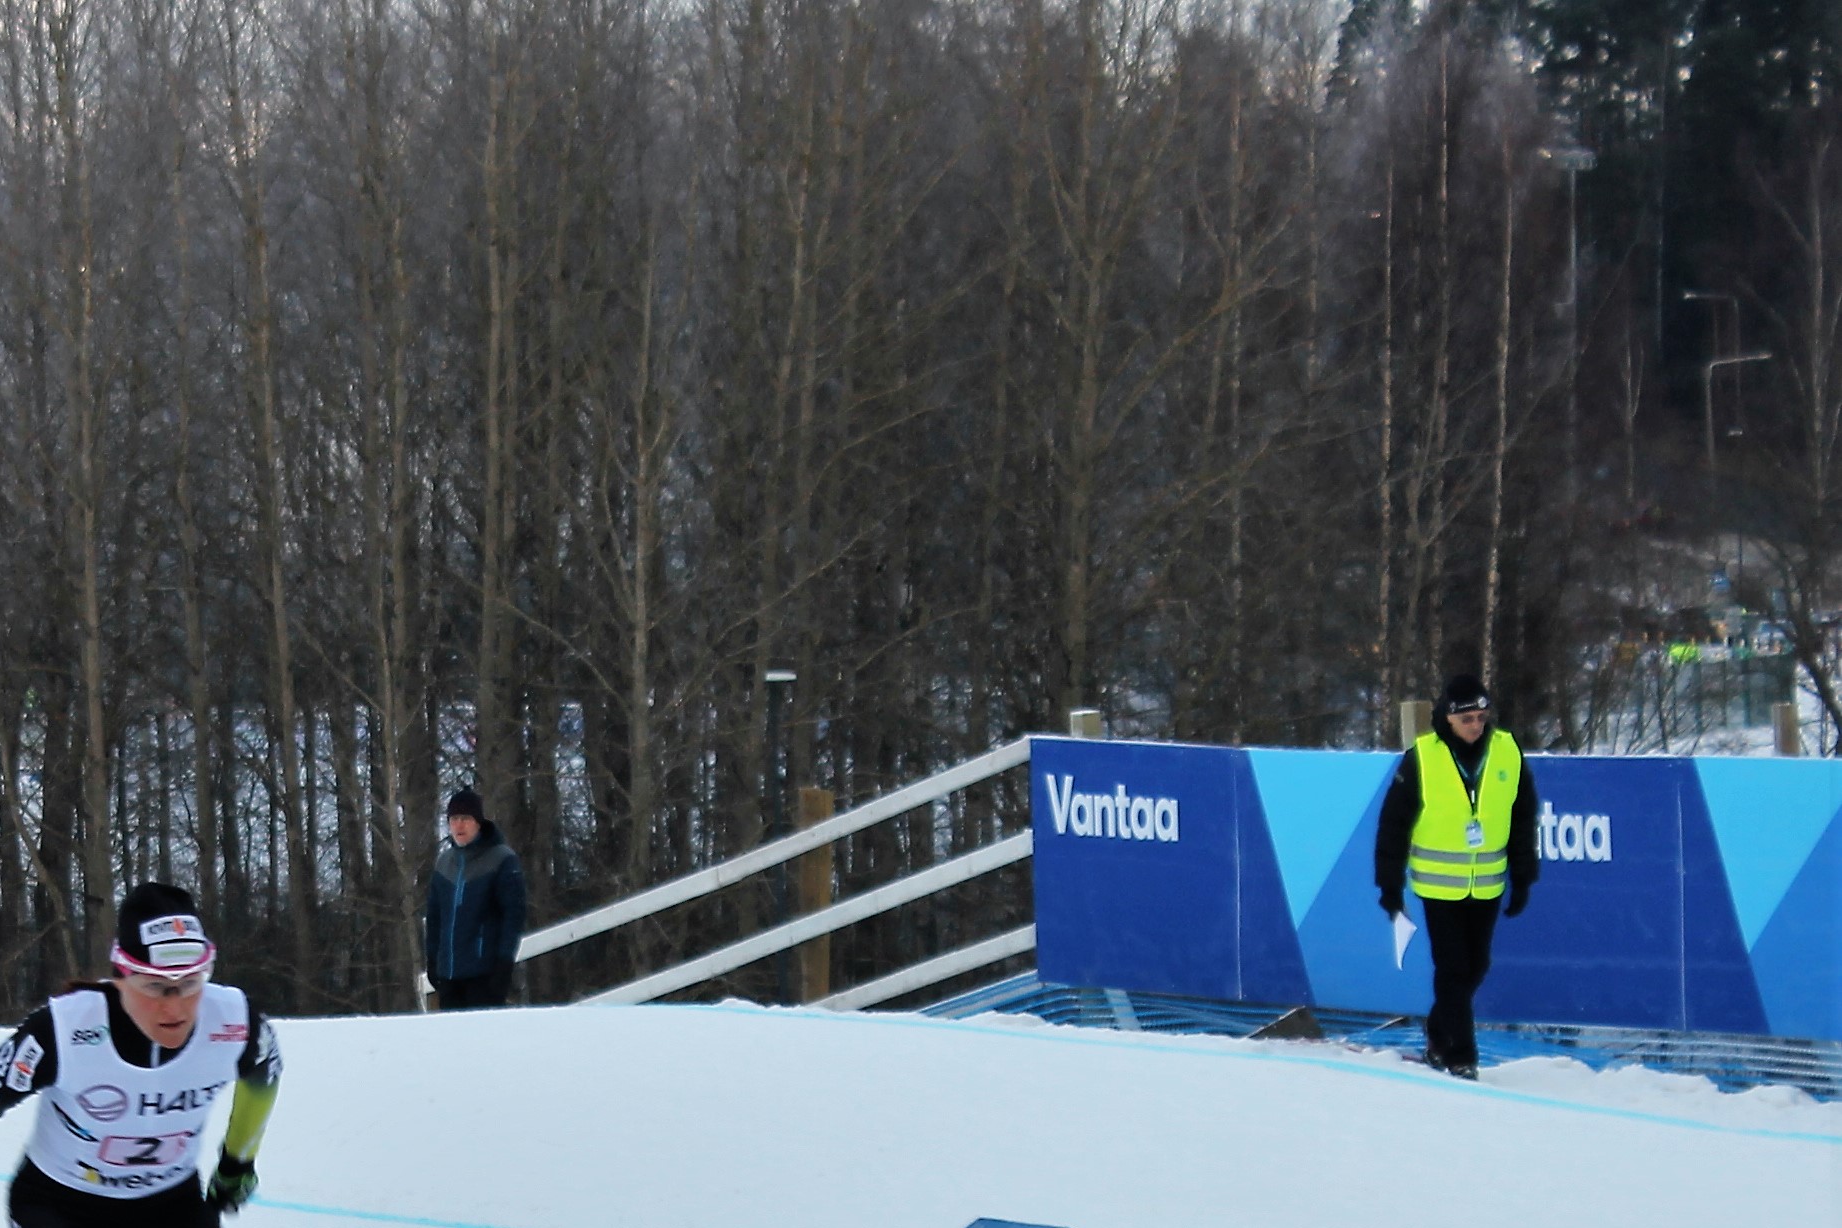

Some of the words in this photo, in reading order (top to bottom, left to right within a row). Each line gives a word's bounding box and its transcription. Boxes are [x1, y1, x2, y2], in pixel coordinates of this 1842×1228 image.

[1046, 773, 1180, 843] Vantaa
[138, 1082, 226, 1116] HALT
[126, 1137, 162, 1164] 2
